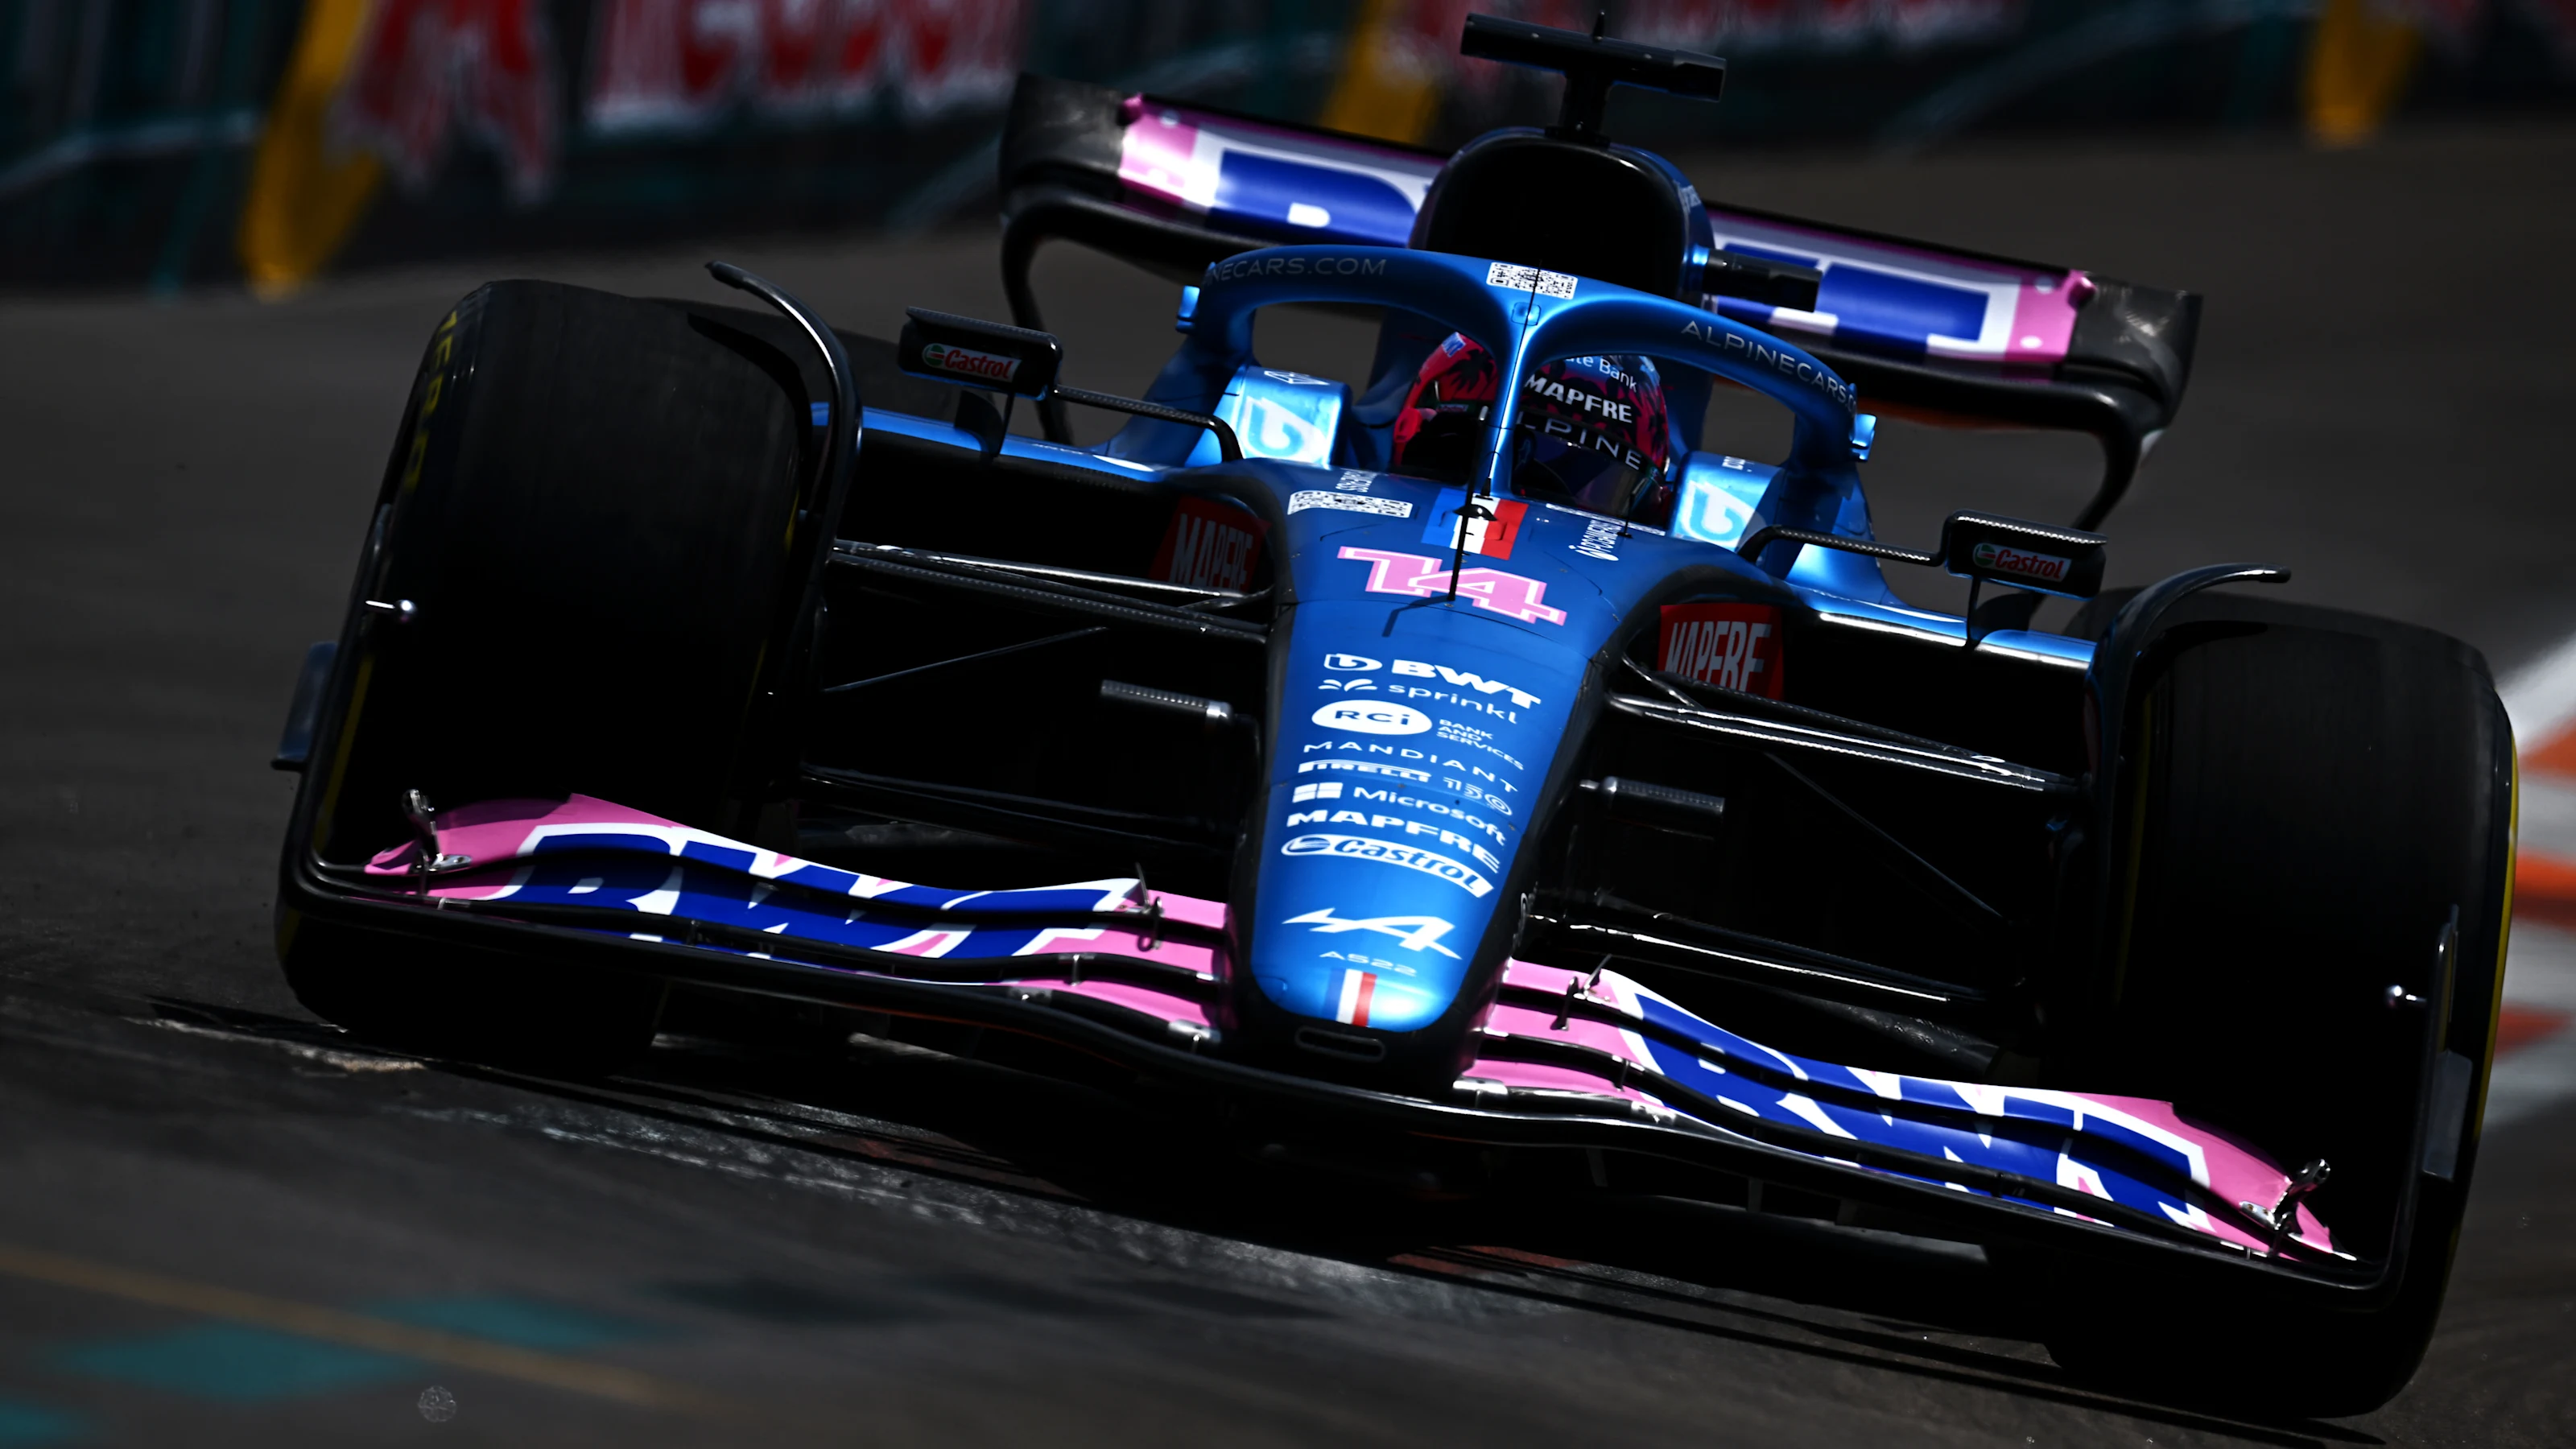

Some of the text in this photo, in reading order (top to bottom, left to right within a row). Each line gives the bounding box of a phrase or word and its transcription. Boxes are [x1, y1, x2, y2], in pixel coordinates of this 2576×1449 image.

[945, 349, 1013, 379] Castrol
[1599, 357, 1637, 393] Bank
[1524, 374, 1633, 423] MAPFRE
[1516, 411, 1643, 471] LPINE
[1336, 546, 1567, 626] 14
[1996, 549, 2064, 579] Castrol
[1391, 658, 1541, 709] BWT
[1436, 731, 1524, 770] SERVICES
[1438, 726, 1482, 741] AND
[1439, 719, 1493, 740] BANK
[1298, 759, 1432, 782] PIRELLI
[1303, 741, 1518, 793] MANDIANT
[1353, 786, 1506, 847] Microsoft
[1286, 809, 1501, 873] MAPFRE
[1334, 840, 1480, 890] Castrol
[1319, 951, 1417, 977] A522
